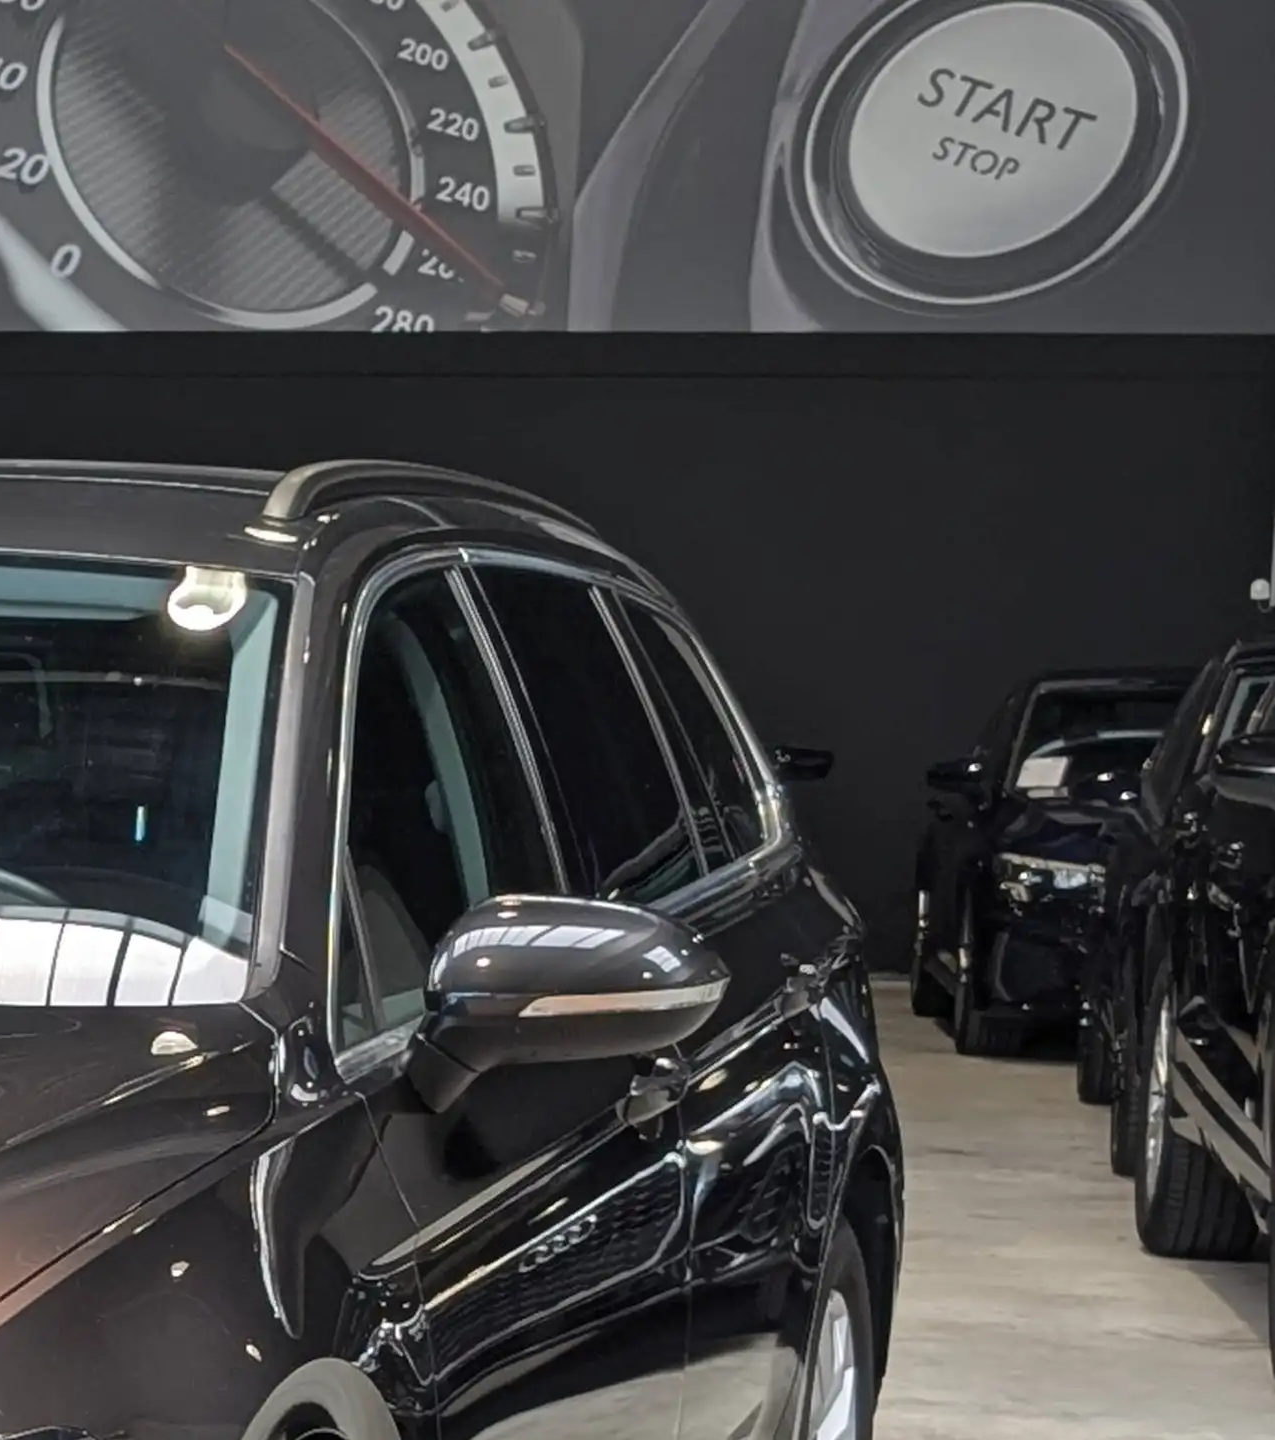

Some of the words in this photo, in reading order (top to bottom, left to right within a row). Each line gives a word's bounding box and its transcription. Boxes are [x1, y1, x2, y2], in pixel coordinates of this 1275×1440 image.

[397, 37, 449, 72] 200
[425, 107, 480, 142] 220
[916, 67, 1098, 151] START
[931, 136, 1021, 181] STOP
[435, 176, 491, 212] 240
[50, 244, 82, 279] 0
